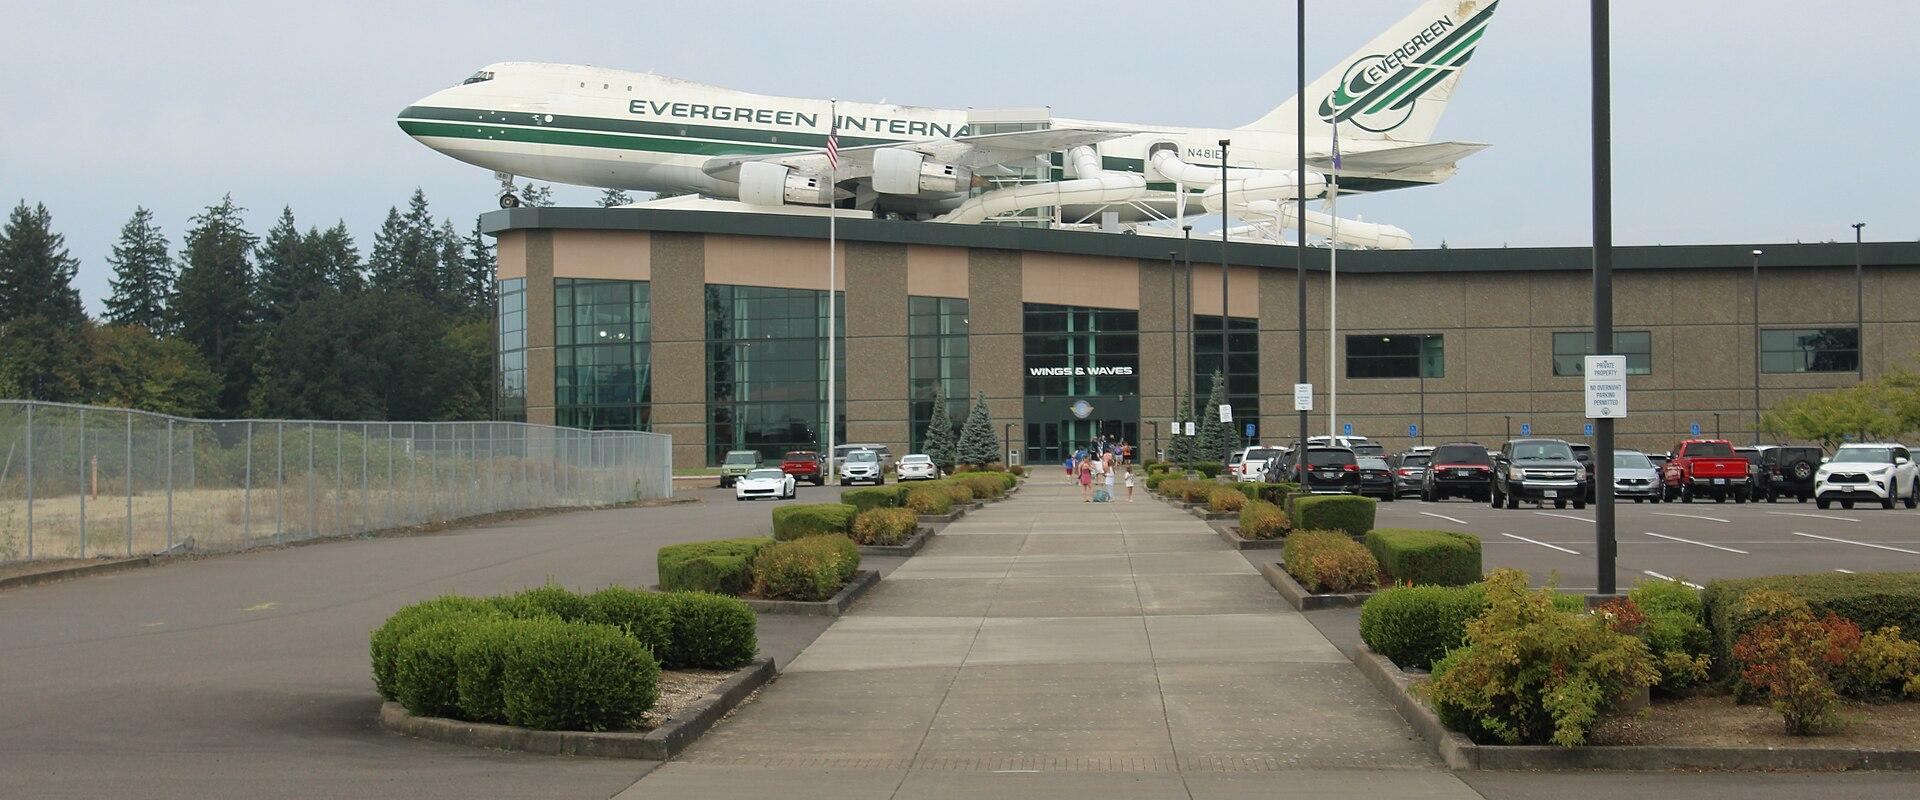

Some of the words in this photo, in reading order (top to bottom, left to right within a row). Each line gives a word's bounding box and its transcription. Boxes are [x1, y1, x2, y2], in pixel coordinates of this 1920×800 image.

[1367, 15, 1455, 82] EVERGREEN
[628, 99, 817, 128] EVERGREEN
[837, 115, 971, 138] INTERNA
[1030, 367, 1073, 376] WINGS
[1075, 367, 1086, 375] &
[1087, 366, 1133, 375] WAVES
